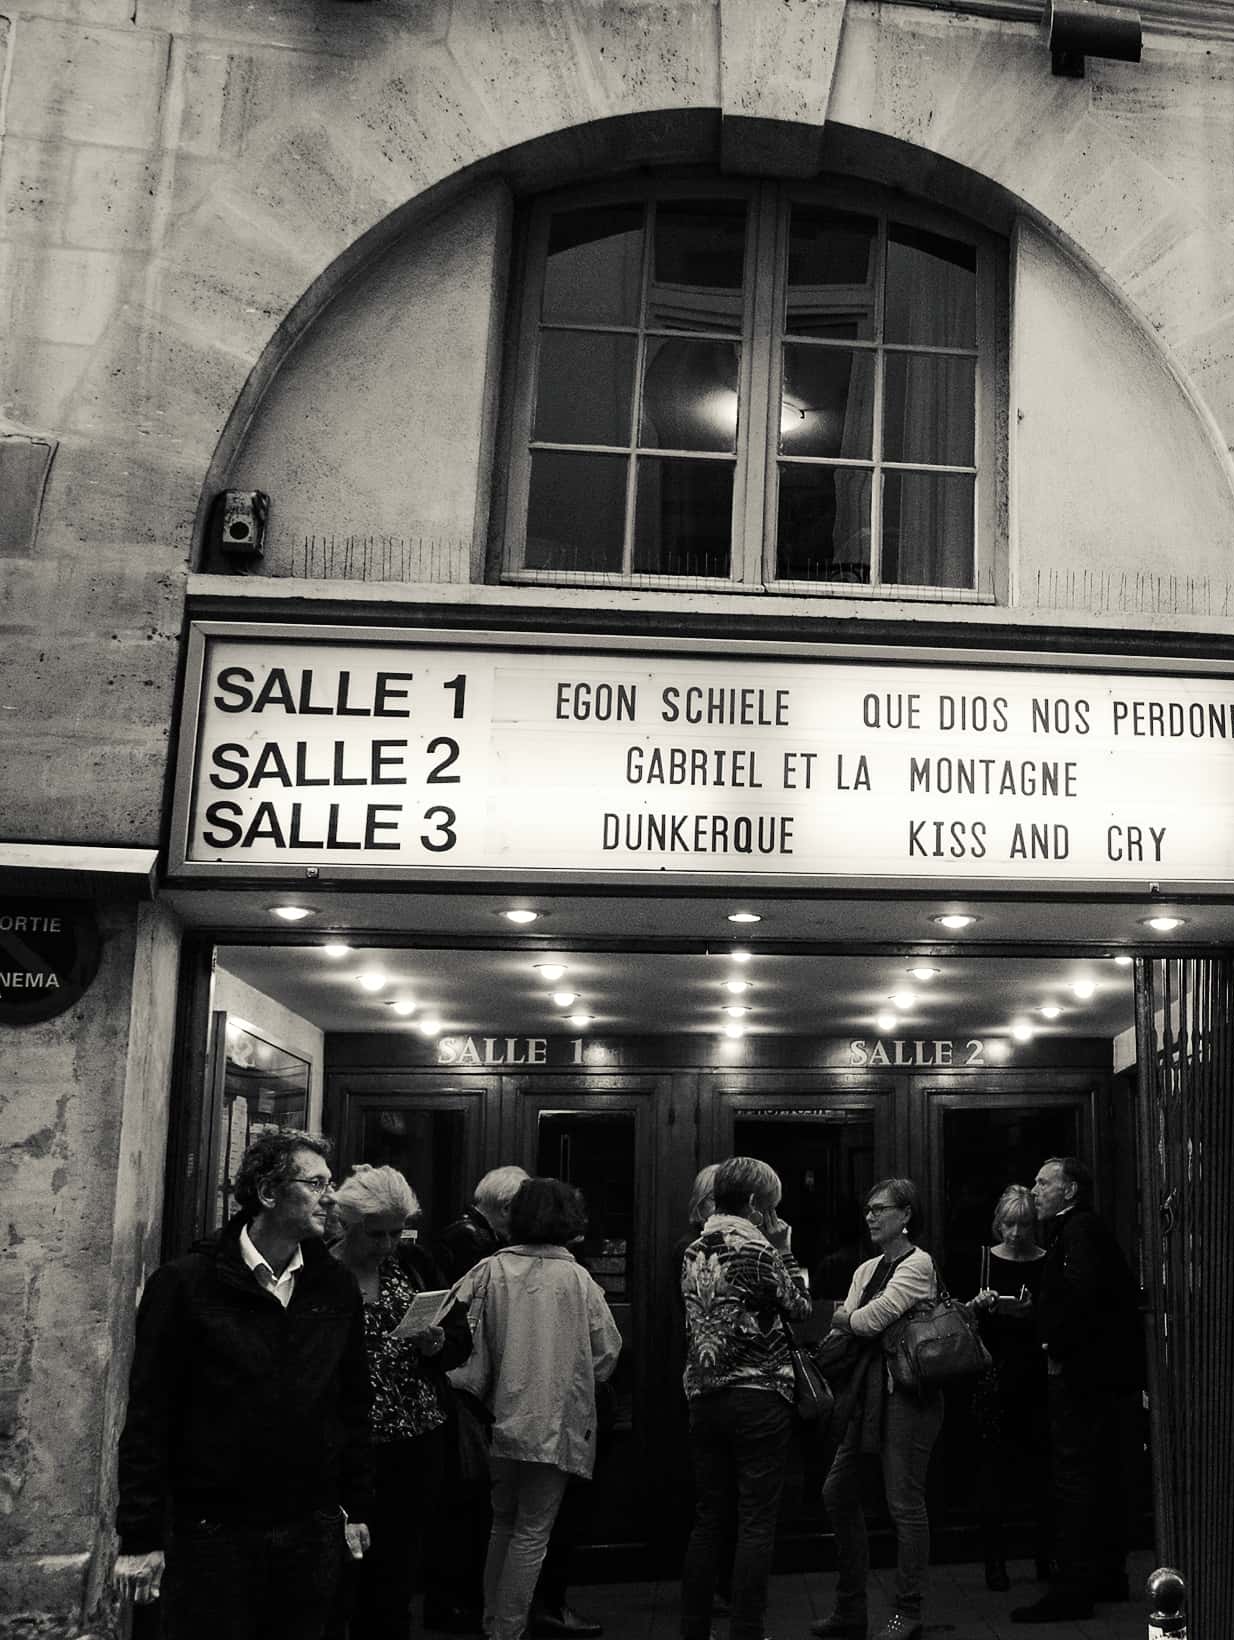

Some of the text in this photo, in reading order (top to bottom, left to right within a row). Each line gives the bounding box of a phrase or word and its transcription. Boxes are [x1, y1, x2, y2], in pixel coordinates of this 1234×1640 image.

[214, 667, 466, 718] SALLE 1
[557, 683, 789, 725] EGON SCHIELE
[864, 695, 919, 728] QUE
[941, 696, 1007, 731] DIOS
[1033, 699, 1089, 734] NOS
[210, 737, 460, 790] SALLE 2
[628, 747, 1076, 796] GABRIEL ET LA MONTAGNE
[203, 801, 456, 852] SALLE 3
[604, 814, 1165, 861] DUNKERQUE KISS AND CRY
[0, 916, 61, 932] ORTIE
[0, 972, 60, 988] NEMA
[438, 1036, 585, 1065] SALLE 1
[850, 1039, 985, 1065] SALLE 2
